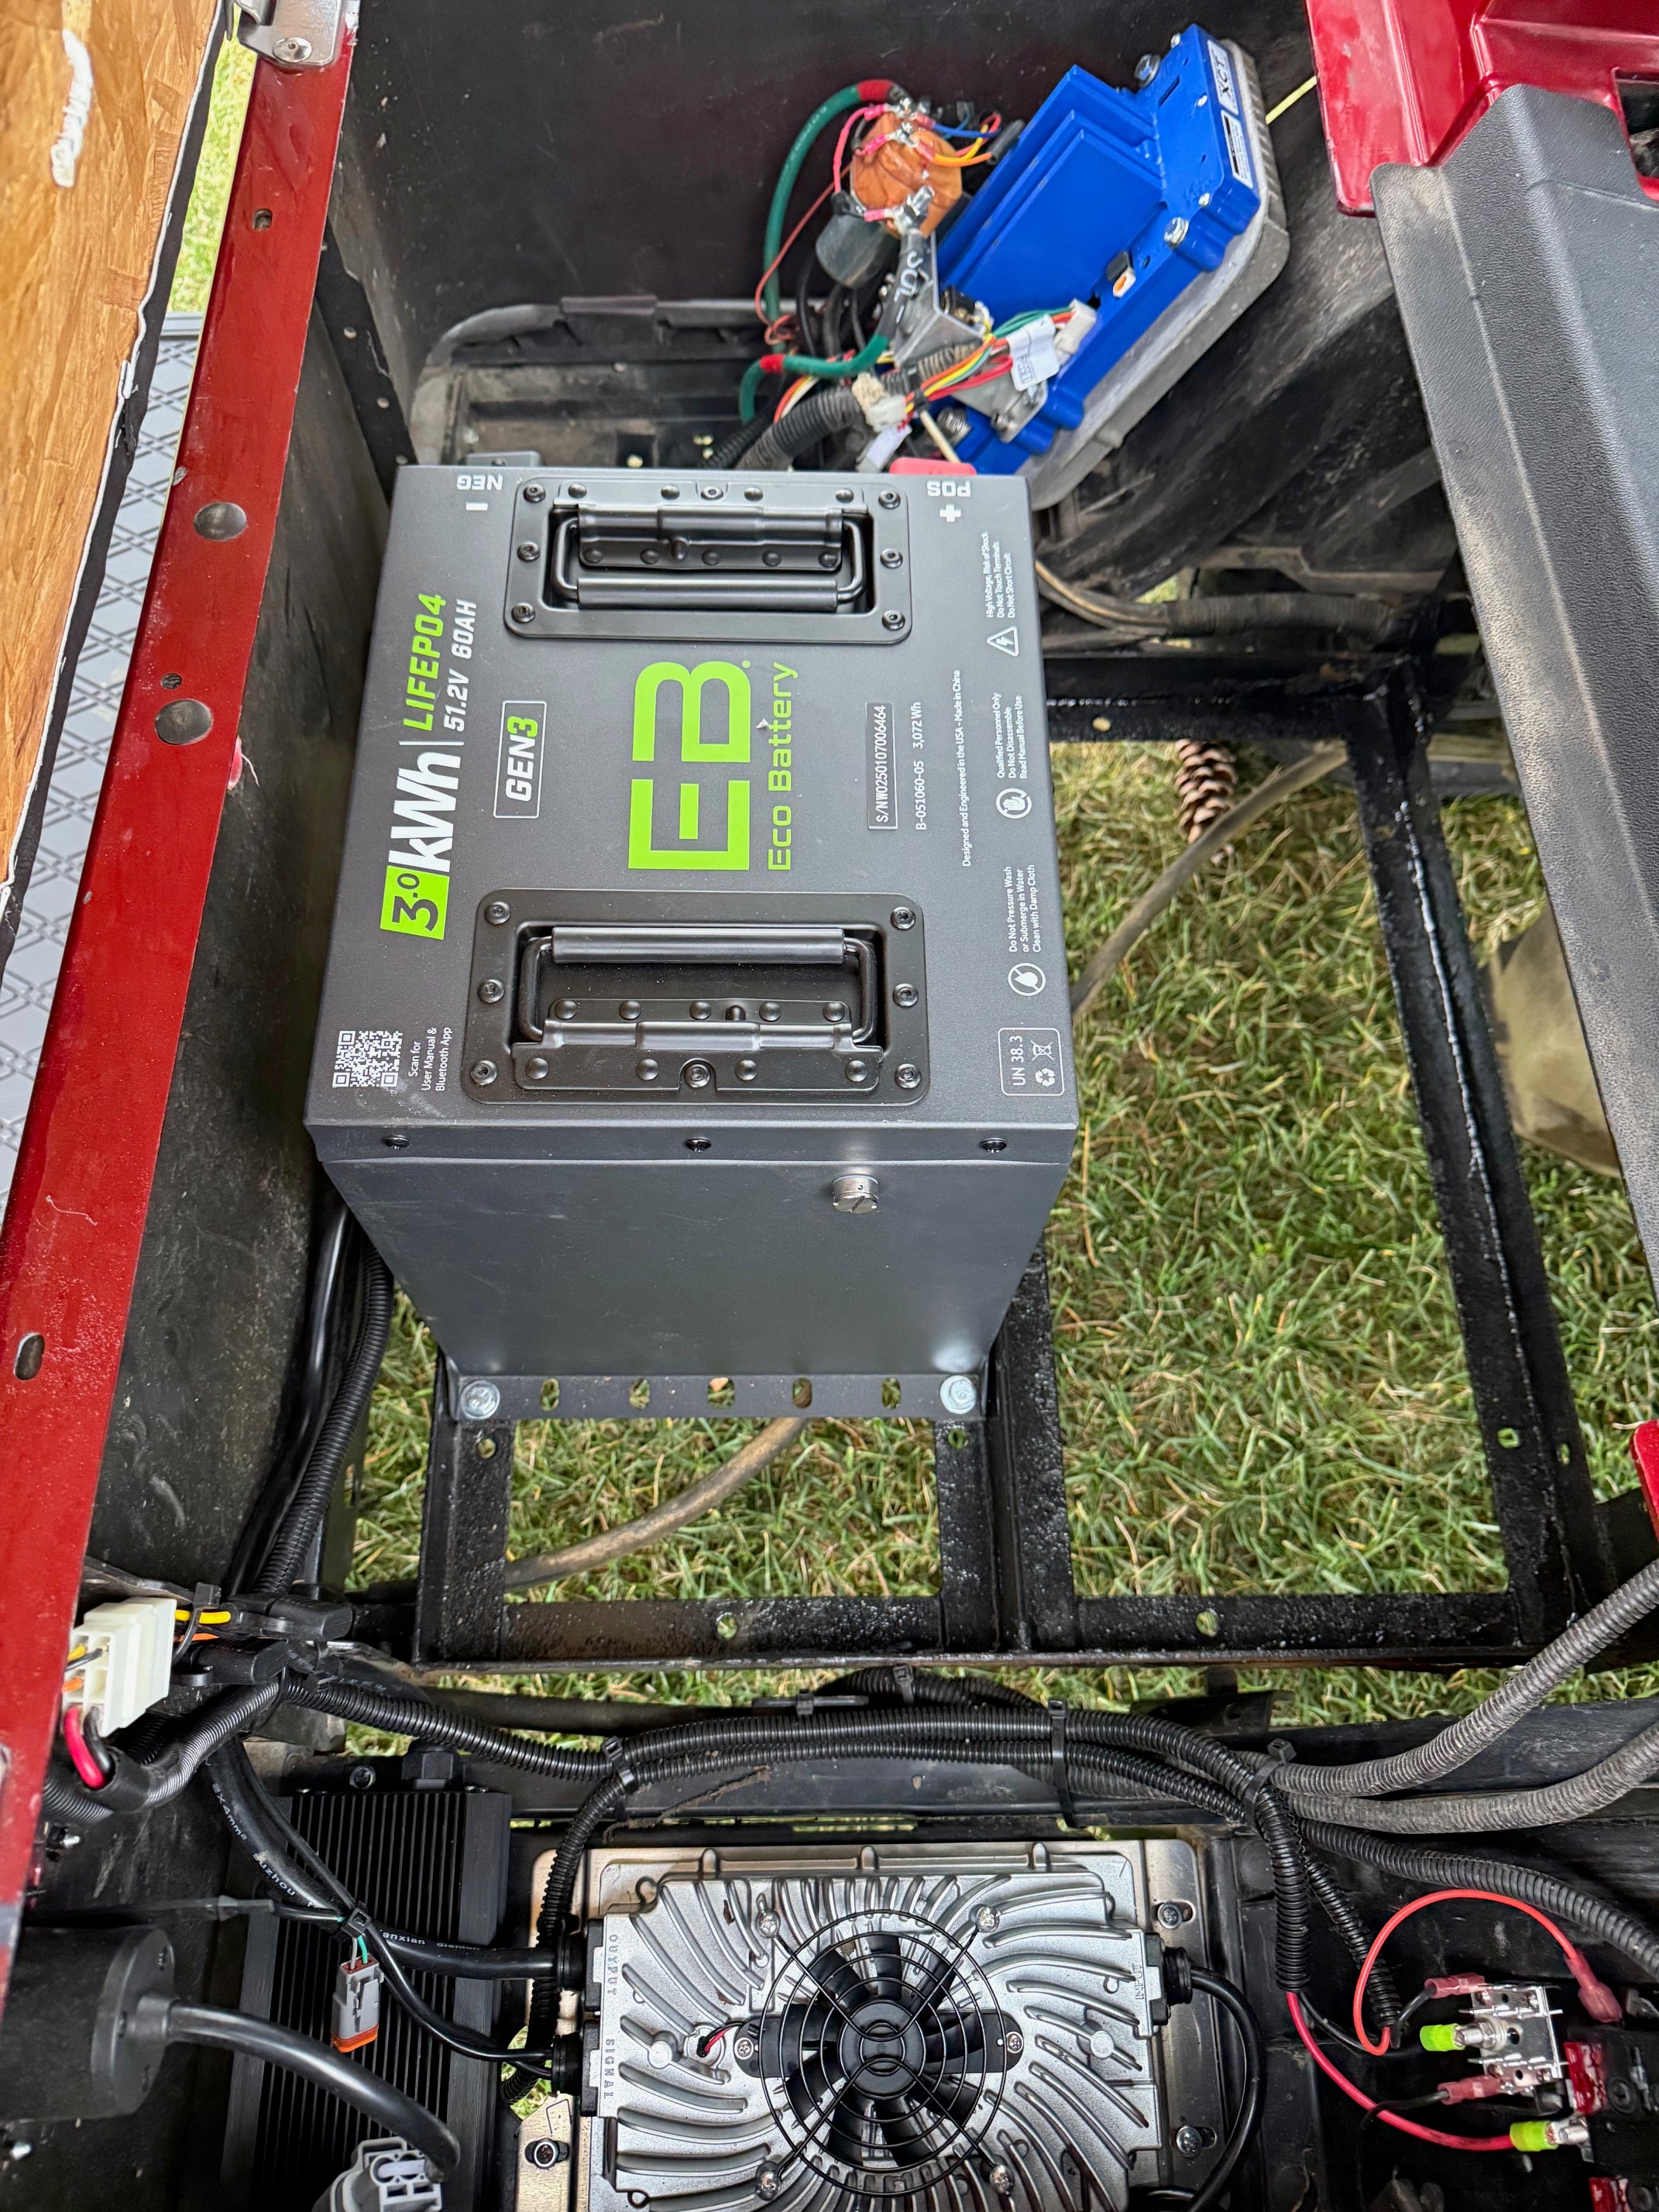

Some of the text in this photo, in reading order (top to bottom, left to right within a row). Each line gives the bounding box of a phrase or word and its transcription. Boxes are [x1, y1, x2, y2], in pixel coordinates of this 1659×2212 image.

[1215, 56, 1231, 98] XCT
[456, 474, 503, 490] NEG
[926, 480, 971, 497] POS
[981, 531, 990, 553] Shock
[982, 559, 991, 574] Risk
[992, 541, 1001, 573] Terminals
[1004, 552, 1012, 575] Circuit
[994, 573, 1003, 594] Touch
[1005, 575, 1014, 594] Short
[985, 601, 995, 618] High
[996, 607, 1005, 618] Do
[1007, 607, 1015, 618] Do
[443, 598, 477, 733] 51.2V 60AH
[953, 670, 961, 692] China
[954, 700, 963, 721] Made
[1015, 710, 1024, 734] Before
[955, 726, 964, 744] USA
[991, 692, 1005, 778] Qualified Personnel Only
[1004, 706, 1016, 778] Do Not Disassemble
[1017, 734, 1026, 760] Manual
[505, 715, 539, 802] GEN3
[957, 744, 965, 758] the
[768, 661, 799, 871] Eco Battery
[910, 702, 927, 830] B-051060-05 3,072 Wh
[1018, 760, 1027, 779] Read
[957, 766, 970, 812] Engineered
[960, 812, 969, 828] and
[960, 828, 973, 867] Designed
[1016, 869, 1025, 892] Water
[1003, 866, 1018, 953] Do Not Pressure Wash
[1026, 864, 1041, 953] Clean with Damp Cloth
[1019, 902, 1029, 942] Submerge
[1022, 943, 1029, 953] or
[408, 1041, 421, 1077] Scan for
[423, 1036, 436, 1069] Manual
[435, 1027, 453, 1091] Bluetooth App
[1009, 1036, 1026, 1086] UN 38.3
[421, 1070, 432, 1091] User
[607, 1934, 619, 1996] OUTPUT
[603, 2039, 616, 2099] SIGNAL
